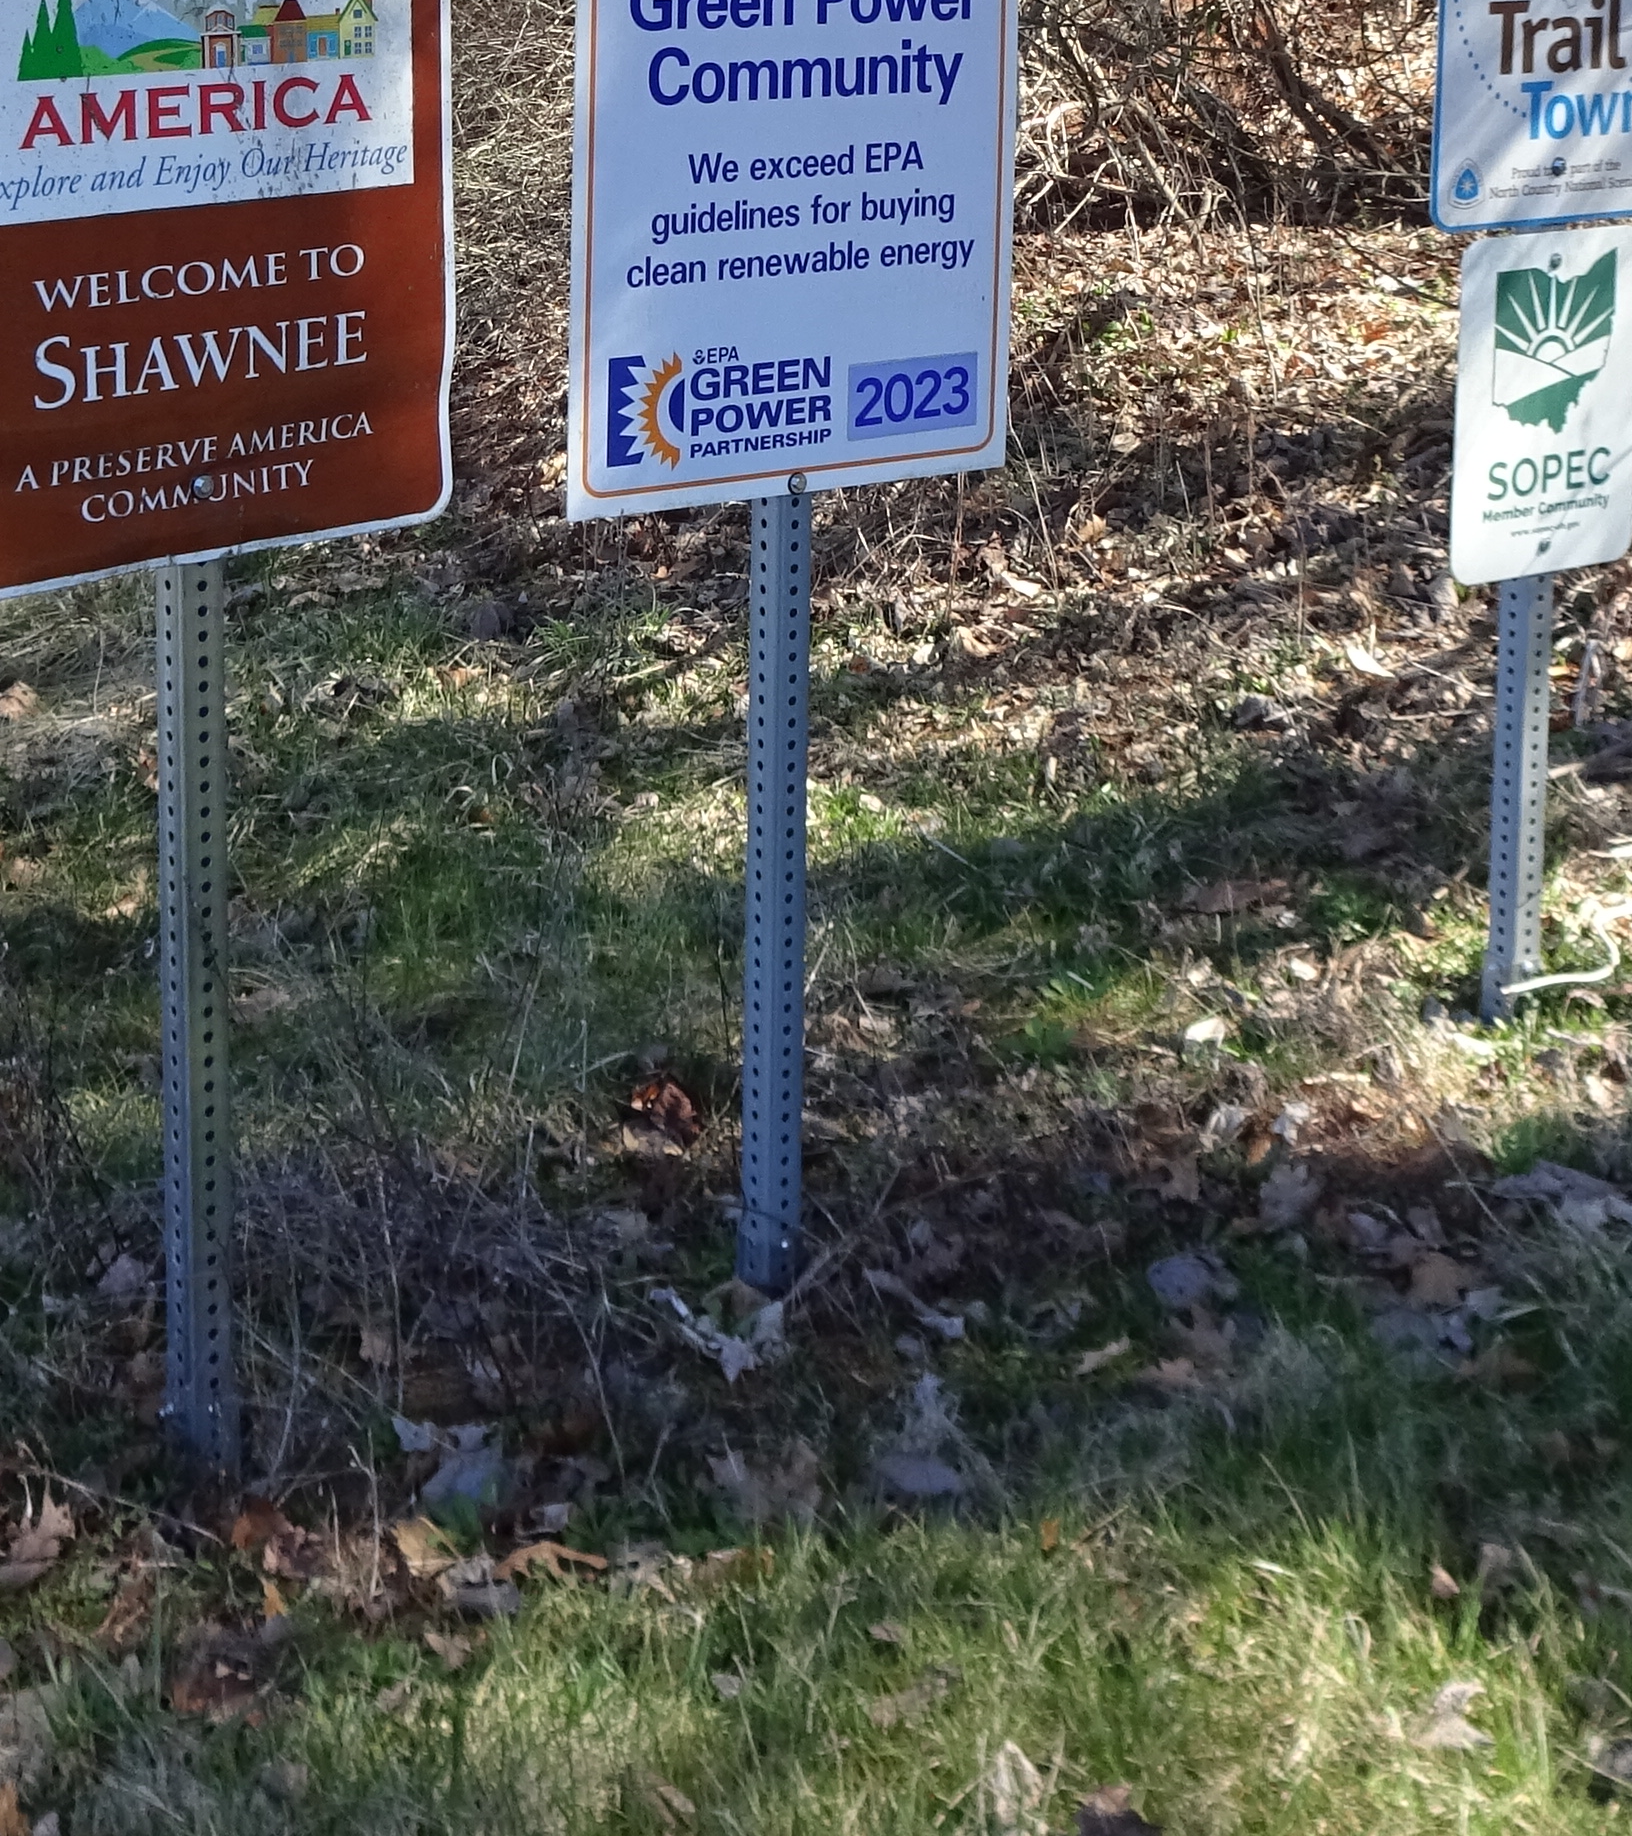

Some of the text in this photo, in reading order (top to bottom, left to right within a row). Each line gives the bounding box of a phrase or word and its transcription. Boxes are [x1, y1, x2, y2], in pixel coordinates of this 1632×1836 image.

[649, 39, 964, 105] Community
[19, 73, 373, 151] AMERICA
[91, 156, 147, 190] and
[154, 150, 231, 190] Enjoy
[240, 146, 297, 178] Our
[305, 140, 408, 177] Heritage
[688, 141, 924, 183] We exceed EPA
[1511, 165, 1540, 180] Proud
[1489, 184, 1519, 200] North
[1521, 182, 1562, 198] Country
[1564, 177, 1606, 193] National
[651, 188, 956, 245] guidelines for buying
[33, 243, 364, 313] WELCOME TO
[626, 237, 975, 288] clean renewable energy
[33, 311, 367, 410] SHAWNEE
[690, 356, 831, 401] GREEN
[707, 346, 739, 364] EPA
[690, 394, 832, 437] POWER
[855, 366, 969, 427] 2023
[15, 411, 374, 493] A PRESERVE AMERICA
[689, 428, 832, 459] PARTNERSHIP
[1487, 447, 1611, 502] SOPEC
[1482, 493, 1610, 524] Member Community
